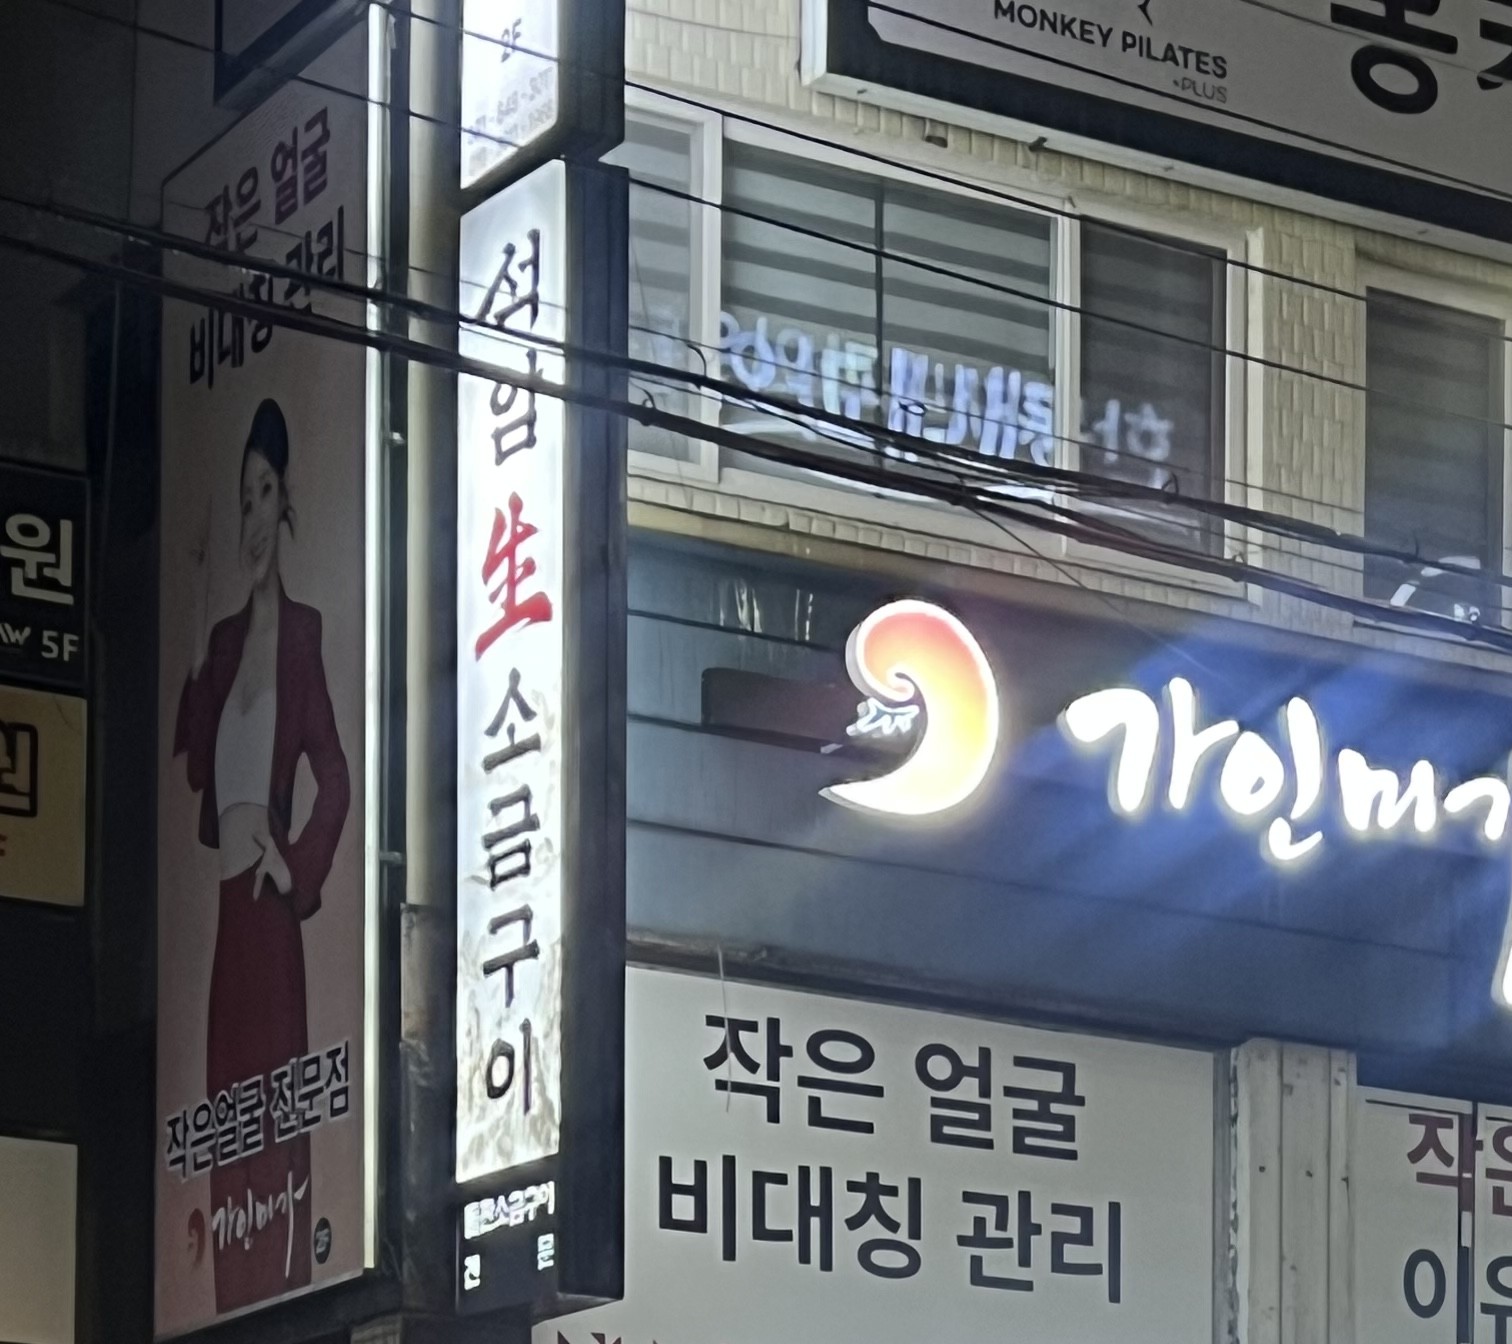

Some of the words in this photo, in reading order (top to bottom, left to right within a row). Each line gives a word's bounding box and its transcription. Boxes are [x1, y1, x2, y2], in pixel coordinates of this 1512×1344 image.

[993, 0, 1114, 48] MONKEY
[1121, 30, 1229, 80] PILATES
[270, 106, 332, 226] 얼굴
[0, 512, 76, 607] 원
[40, 629, 81, 662] 5F
[269, 1038, 351, 1144] 전문점
[703, 1012, 885, 1135] 작은
[914, 1041, 1087, 1162] 얼굴
[657, 1154, 924, 1280] 비대칭
[955, 1188, 1123, 1304] 관리
